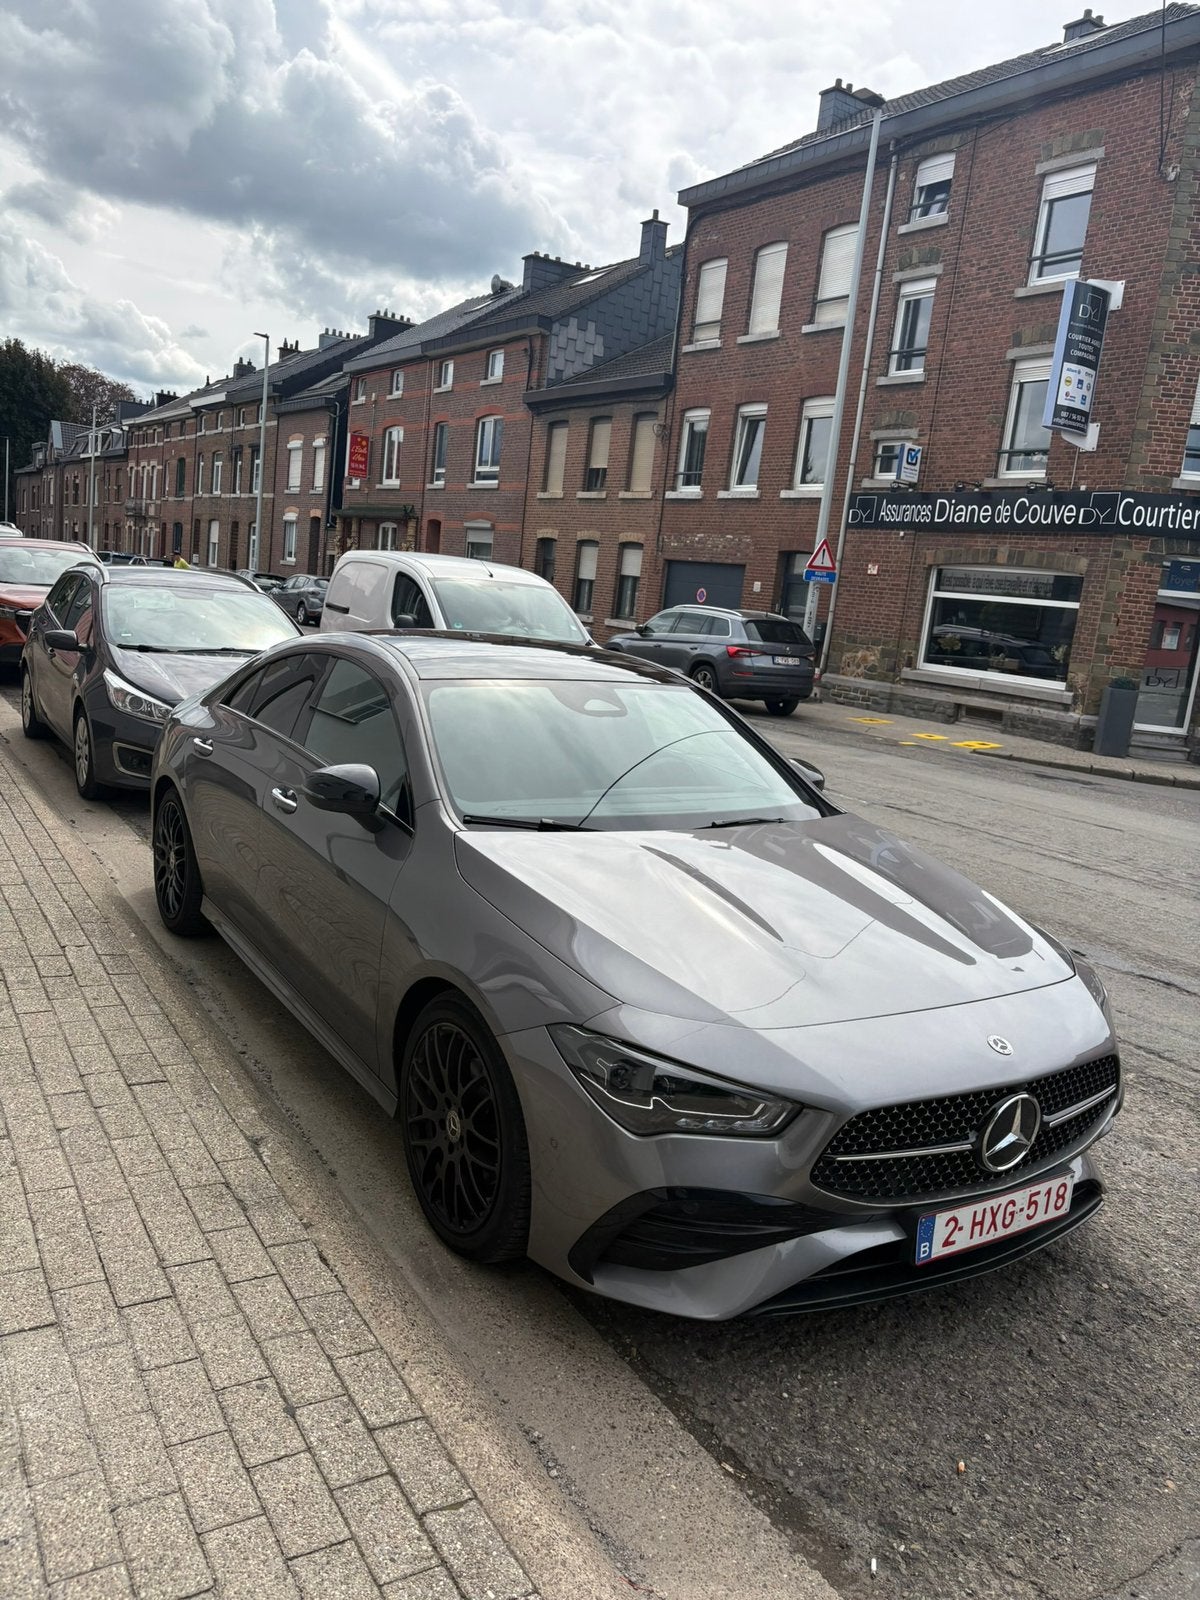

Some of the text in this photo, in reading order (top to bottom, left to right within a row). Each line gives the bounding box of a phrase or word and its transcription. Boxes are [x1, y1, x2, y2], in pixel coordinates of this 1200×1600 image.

[1068, 332, 1091, 343] COURTIER
[1078, 342, 1094, 352] TOUTES
[878, 498, 932, 522] Assurances
[934, 498, 992, 524] Diane
[994, 499, 1010, 524] de
[1014, 498, 1076, 524] Couve
[942, 1182, 1068, 1248] 2-HXG-518
[920, 1242, 930, 1258] B
